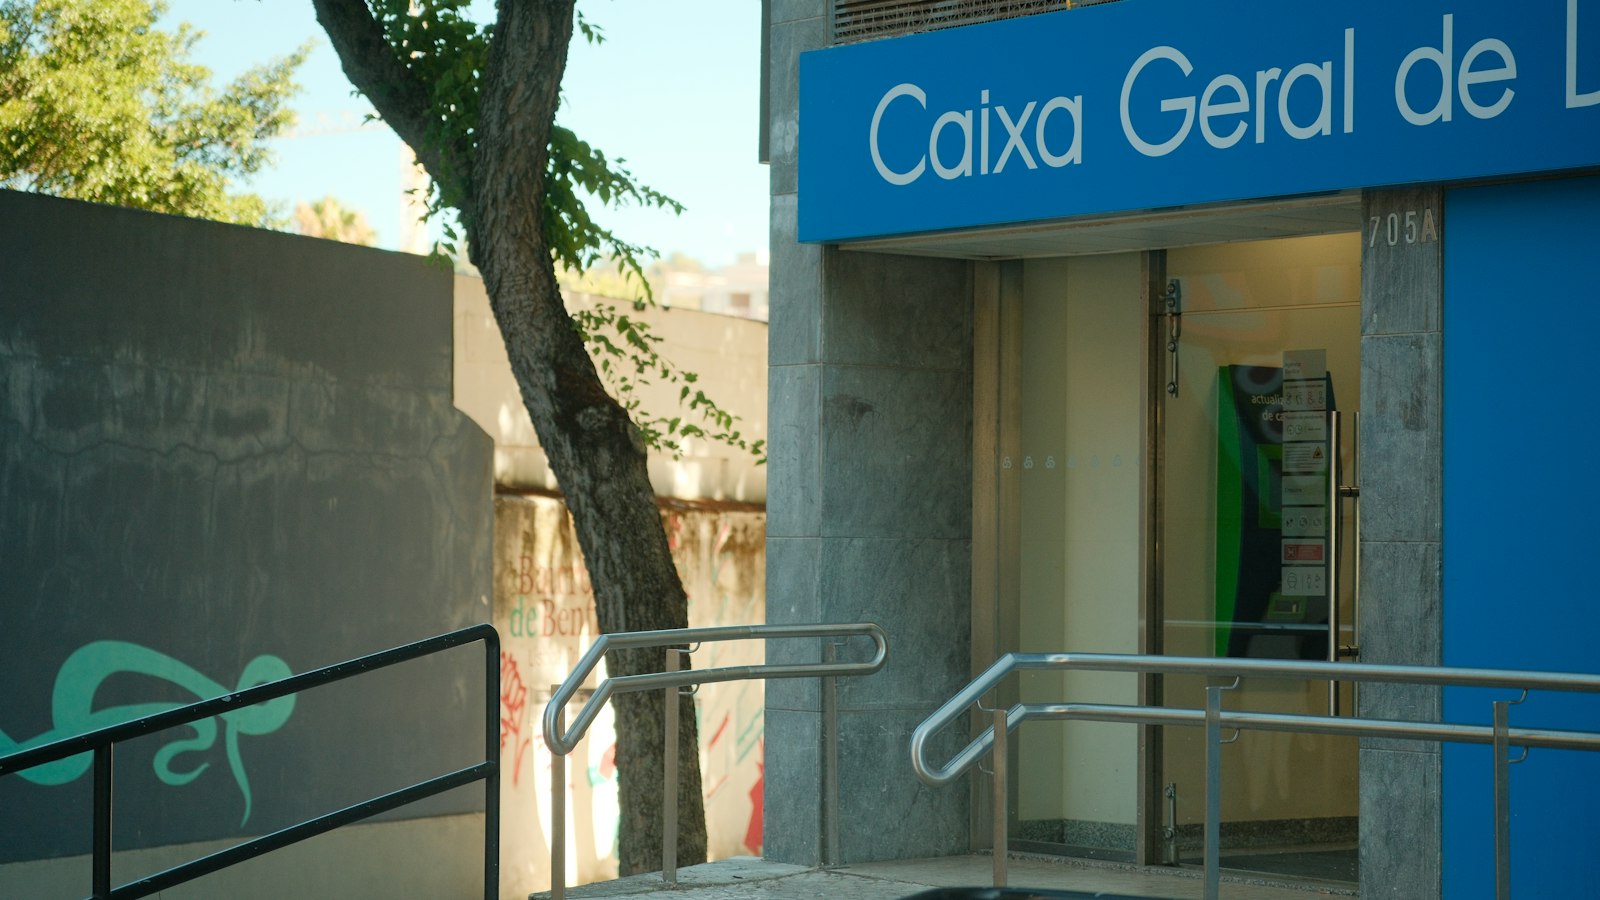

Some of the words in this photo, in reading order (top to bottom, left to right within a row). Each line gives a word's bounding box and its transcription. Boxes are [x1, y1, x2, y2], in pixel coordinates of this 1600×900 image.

[869, 82, 1083, 187] Caixa
[1119, 27, 1355, 158] Geral
[1394, 13, 1517, 126] de
[1369, 208, 1438, 248] 705A
[1262, 409, 1274, 421] de
[510, 594, 537, 638] de
[542, 598, 600, 637] Benf
